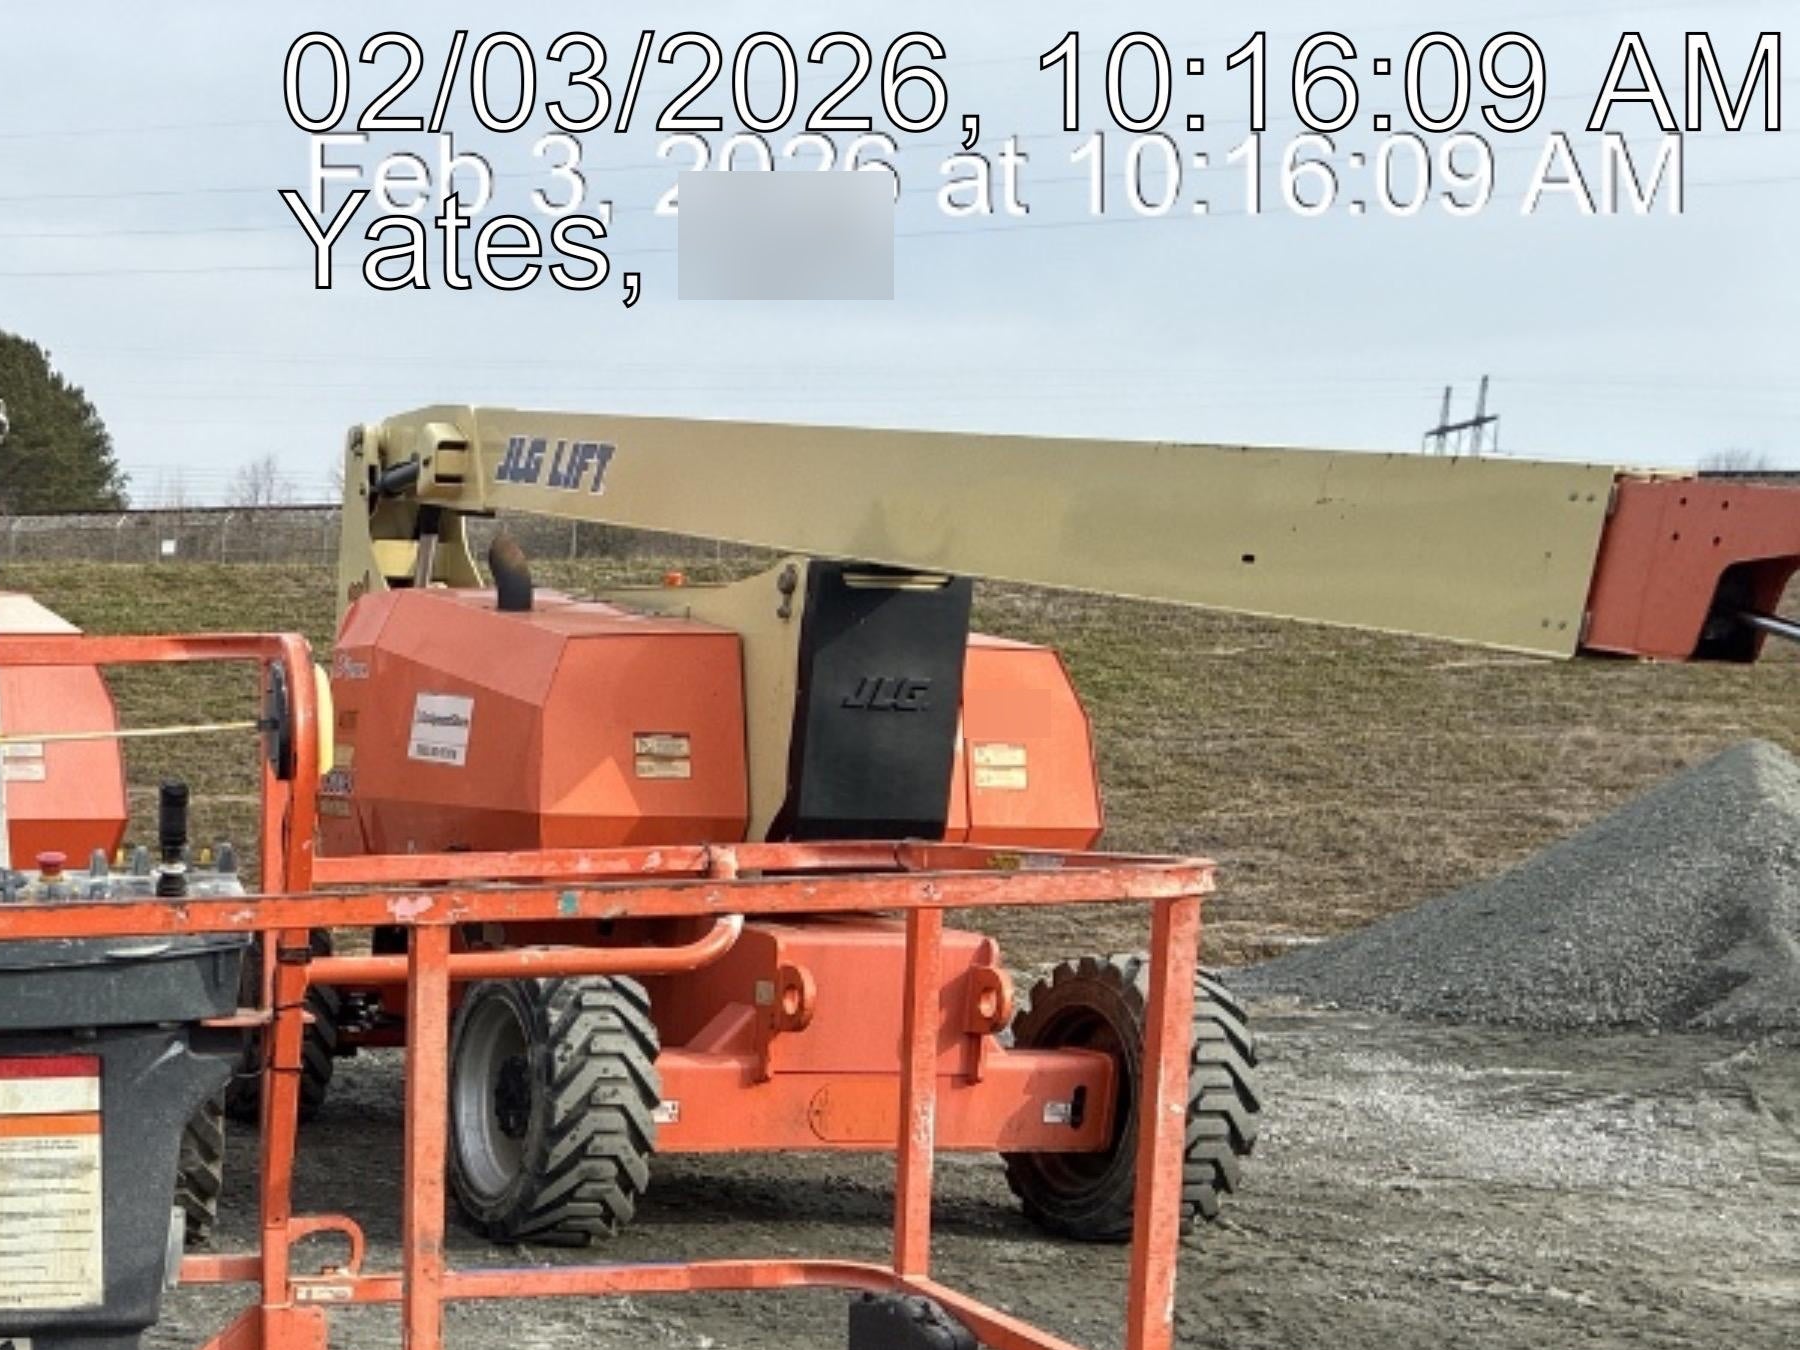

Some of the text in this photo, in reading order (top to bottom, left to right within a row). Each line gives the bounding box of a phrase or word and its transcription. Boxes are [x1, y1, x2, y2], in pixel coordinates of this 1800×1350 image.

[494, 435, 617, 496] JLG LIFT
[840, 676, 929, 712] JLG
